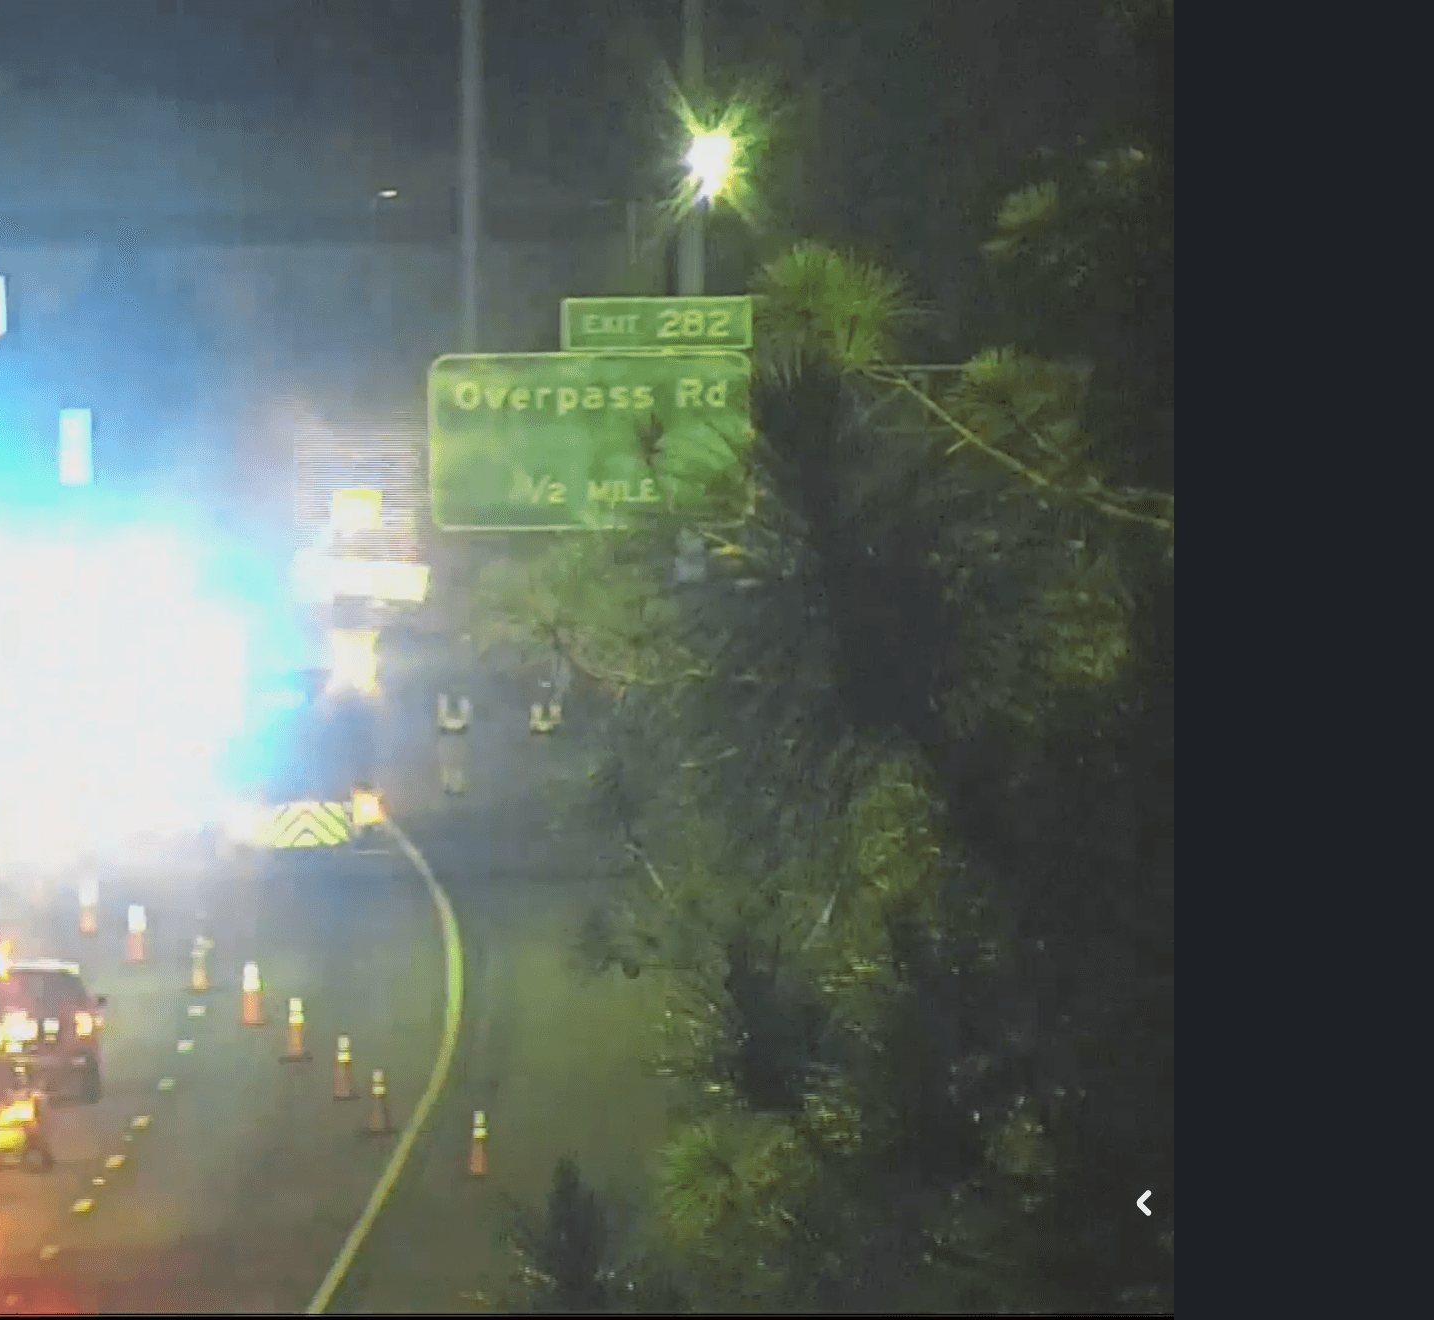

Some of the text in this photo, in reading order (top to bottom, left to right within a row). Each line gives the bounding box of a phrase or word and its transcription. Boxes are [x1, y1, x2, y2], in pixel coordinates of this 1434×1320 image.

[583, 309, 731, 338] EXIT 282
[454, 377, 728, 416] Overpass Rd
[587, 478, 661, 503] MILE
